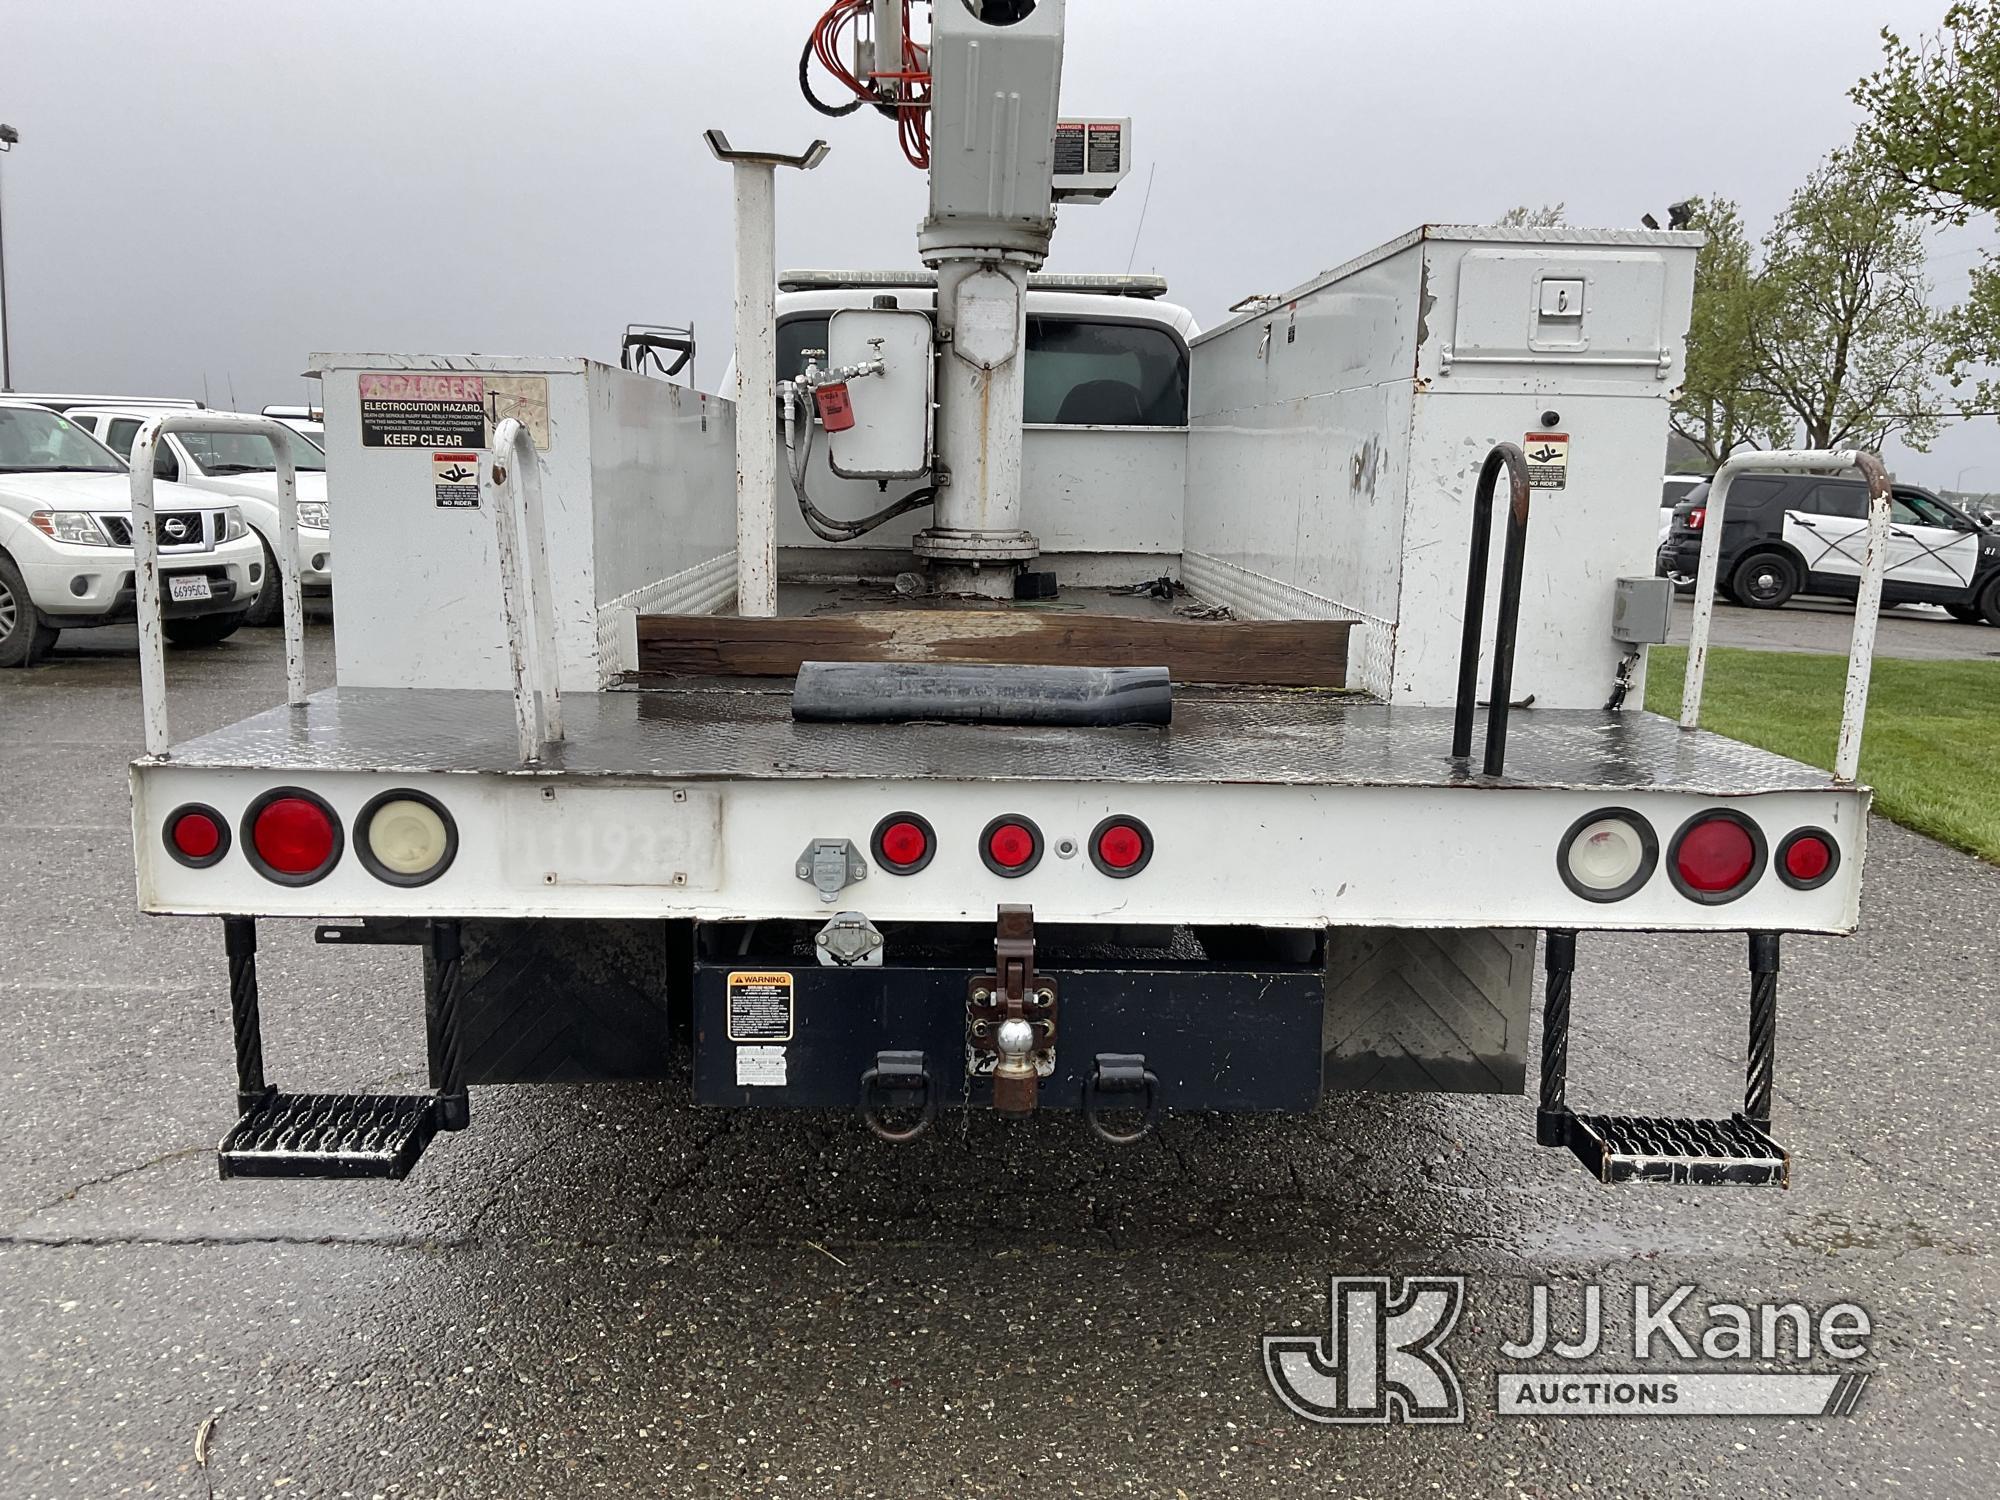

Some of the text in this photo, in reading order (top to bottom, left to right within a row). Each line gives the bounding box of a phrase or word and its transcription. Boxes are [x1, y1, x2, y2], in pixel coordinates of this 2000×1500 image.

[389, 378, 480, 401] DANGER
[364, 402, 441, 412] ELECTROCUTION
[384, 434, 462, 446] KEEP CLEAR
